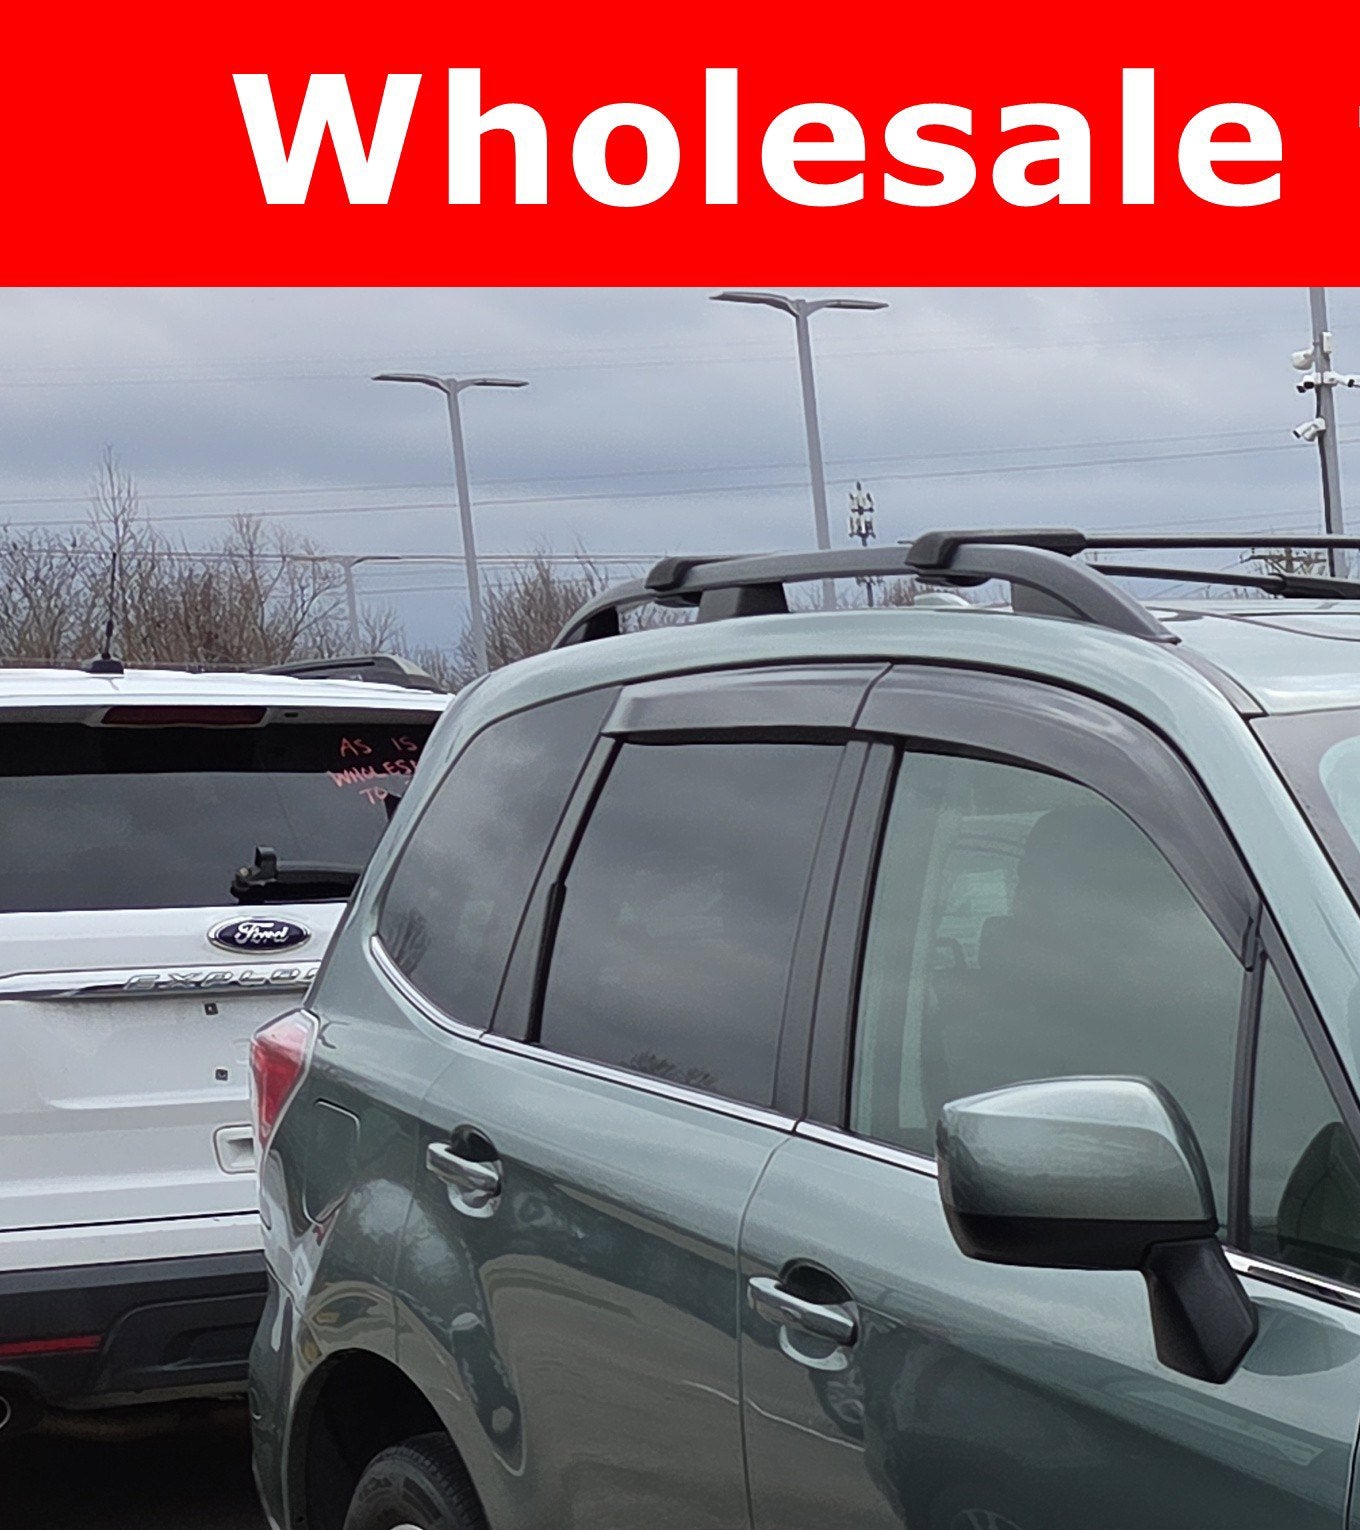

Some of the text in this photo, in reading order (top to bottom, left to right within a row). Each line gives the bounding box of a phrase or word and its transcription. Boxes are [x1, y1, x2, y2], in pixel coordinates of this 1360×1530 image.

[340, 736, 418, 758] AS IS
[358, 785, 389, 805] TO
[235, 921, 291, 945] Ford
